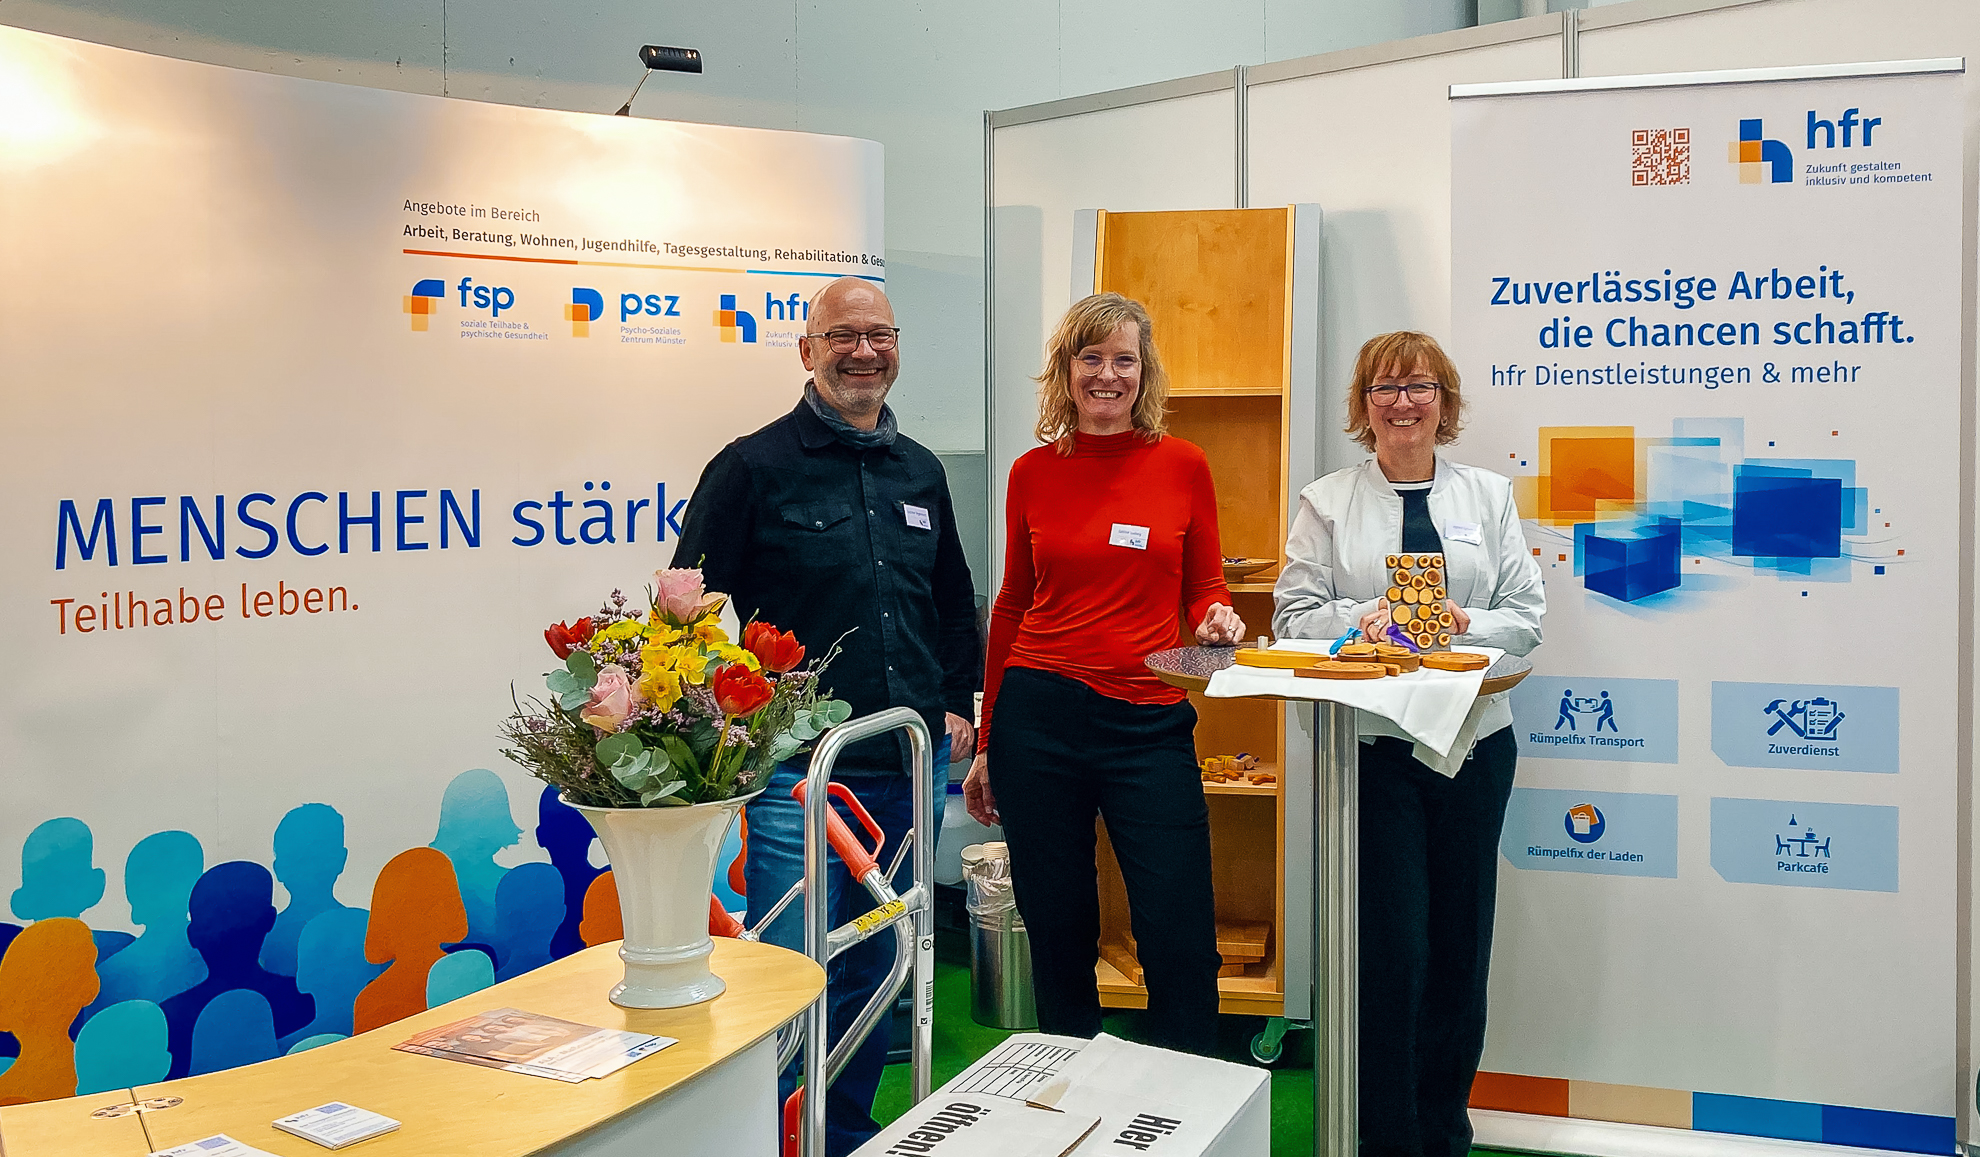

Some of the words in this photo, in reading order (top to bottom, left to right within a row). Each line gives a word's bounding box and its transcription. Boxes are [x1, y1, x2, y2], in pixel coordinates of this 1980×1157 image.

[1807, 108, 1881, 149] hfr
[1806, 163, 1847, 173] Zukunft
[1850, 161, 1901, 174] gestalten
[1806, 175, 1847, 186] inklusiv
[1850, 175, 1870, 184] und
[1874, 173, 1932, 183] kompetent
[403, 199, 466, 216] Angebote
[470, 204, 486, 218] im
[491, 207, 540, 222] Bereich
[403, 224, 449, 242] Arbeit,
[452, 228, 517, 247] Beratung,
[520, 233, 578, 251] Wohnen,
[581, 237, 661, 256] Jugendhilfe,
[663, 242, 771, 262] Tagesgestaltung,
[775, 249, 858, 263] Rehabilitation
[861, 254, 869, 264] &
[457, 277, 515, 317] fsp
[1491, 268, 1717, 309] Zuverlässige
[1728, 265, 1855, 305] Arbeit,
[621, 293, 681, 323] psz
[461, 320, 488, 328] soziale
[489, 321, 522, 330] Teilhabe
[461, 330, 503, 339] psychische
[505, 331, 549, 341] Gesundheit
[621, 326, 681, 336] Psycho-Soziales
[1539, 316, 1593, 348] die
[1606, 316, 1760, 347] Chancen
[1773, 311, 1915, 345] schafft.
[621, 336, 654, 344] Zentrum
[655, 336, 687, 345] Münster
[1491, 364, 1526, 386] hfr
[1536, 362, 1751, 389] Dienstleistungen
[1762, 362, 1781, 384] &
[1791, 360, 1861, 383] mehr
[54, 488, 482, 571] MENSCHEN
[51, 588, 225, 635] Teilhabe
[241, 582, 359, 619] leben.
[1529, 733, 1586, 746] Rümpelfix
[1589, 735, 1645, 748] Transport
[1768, 743, 1840, 757] Zuverdienst
[1527, 845, 1584, 859] Rümpelfix
[1587, 849, 1606, 860] der
[1609, 851, 1644, 862] Laden
[1777, 861, 1829, 874] Parkcafé
[1113, 1113, 1182, 1151] Hier
